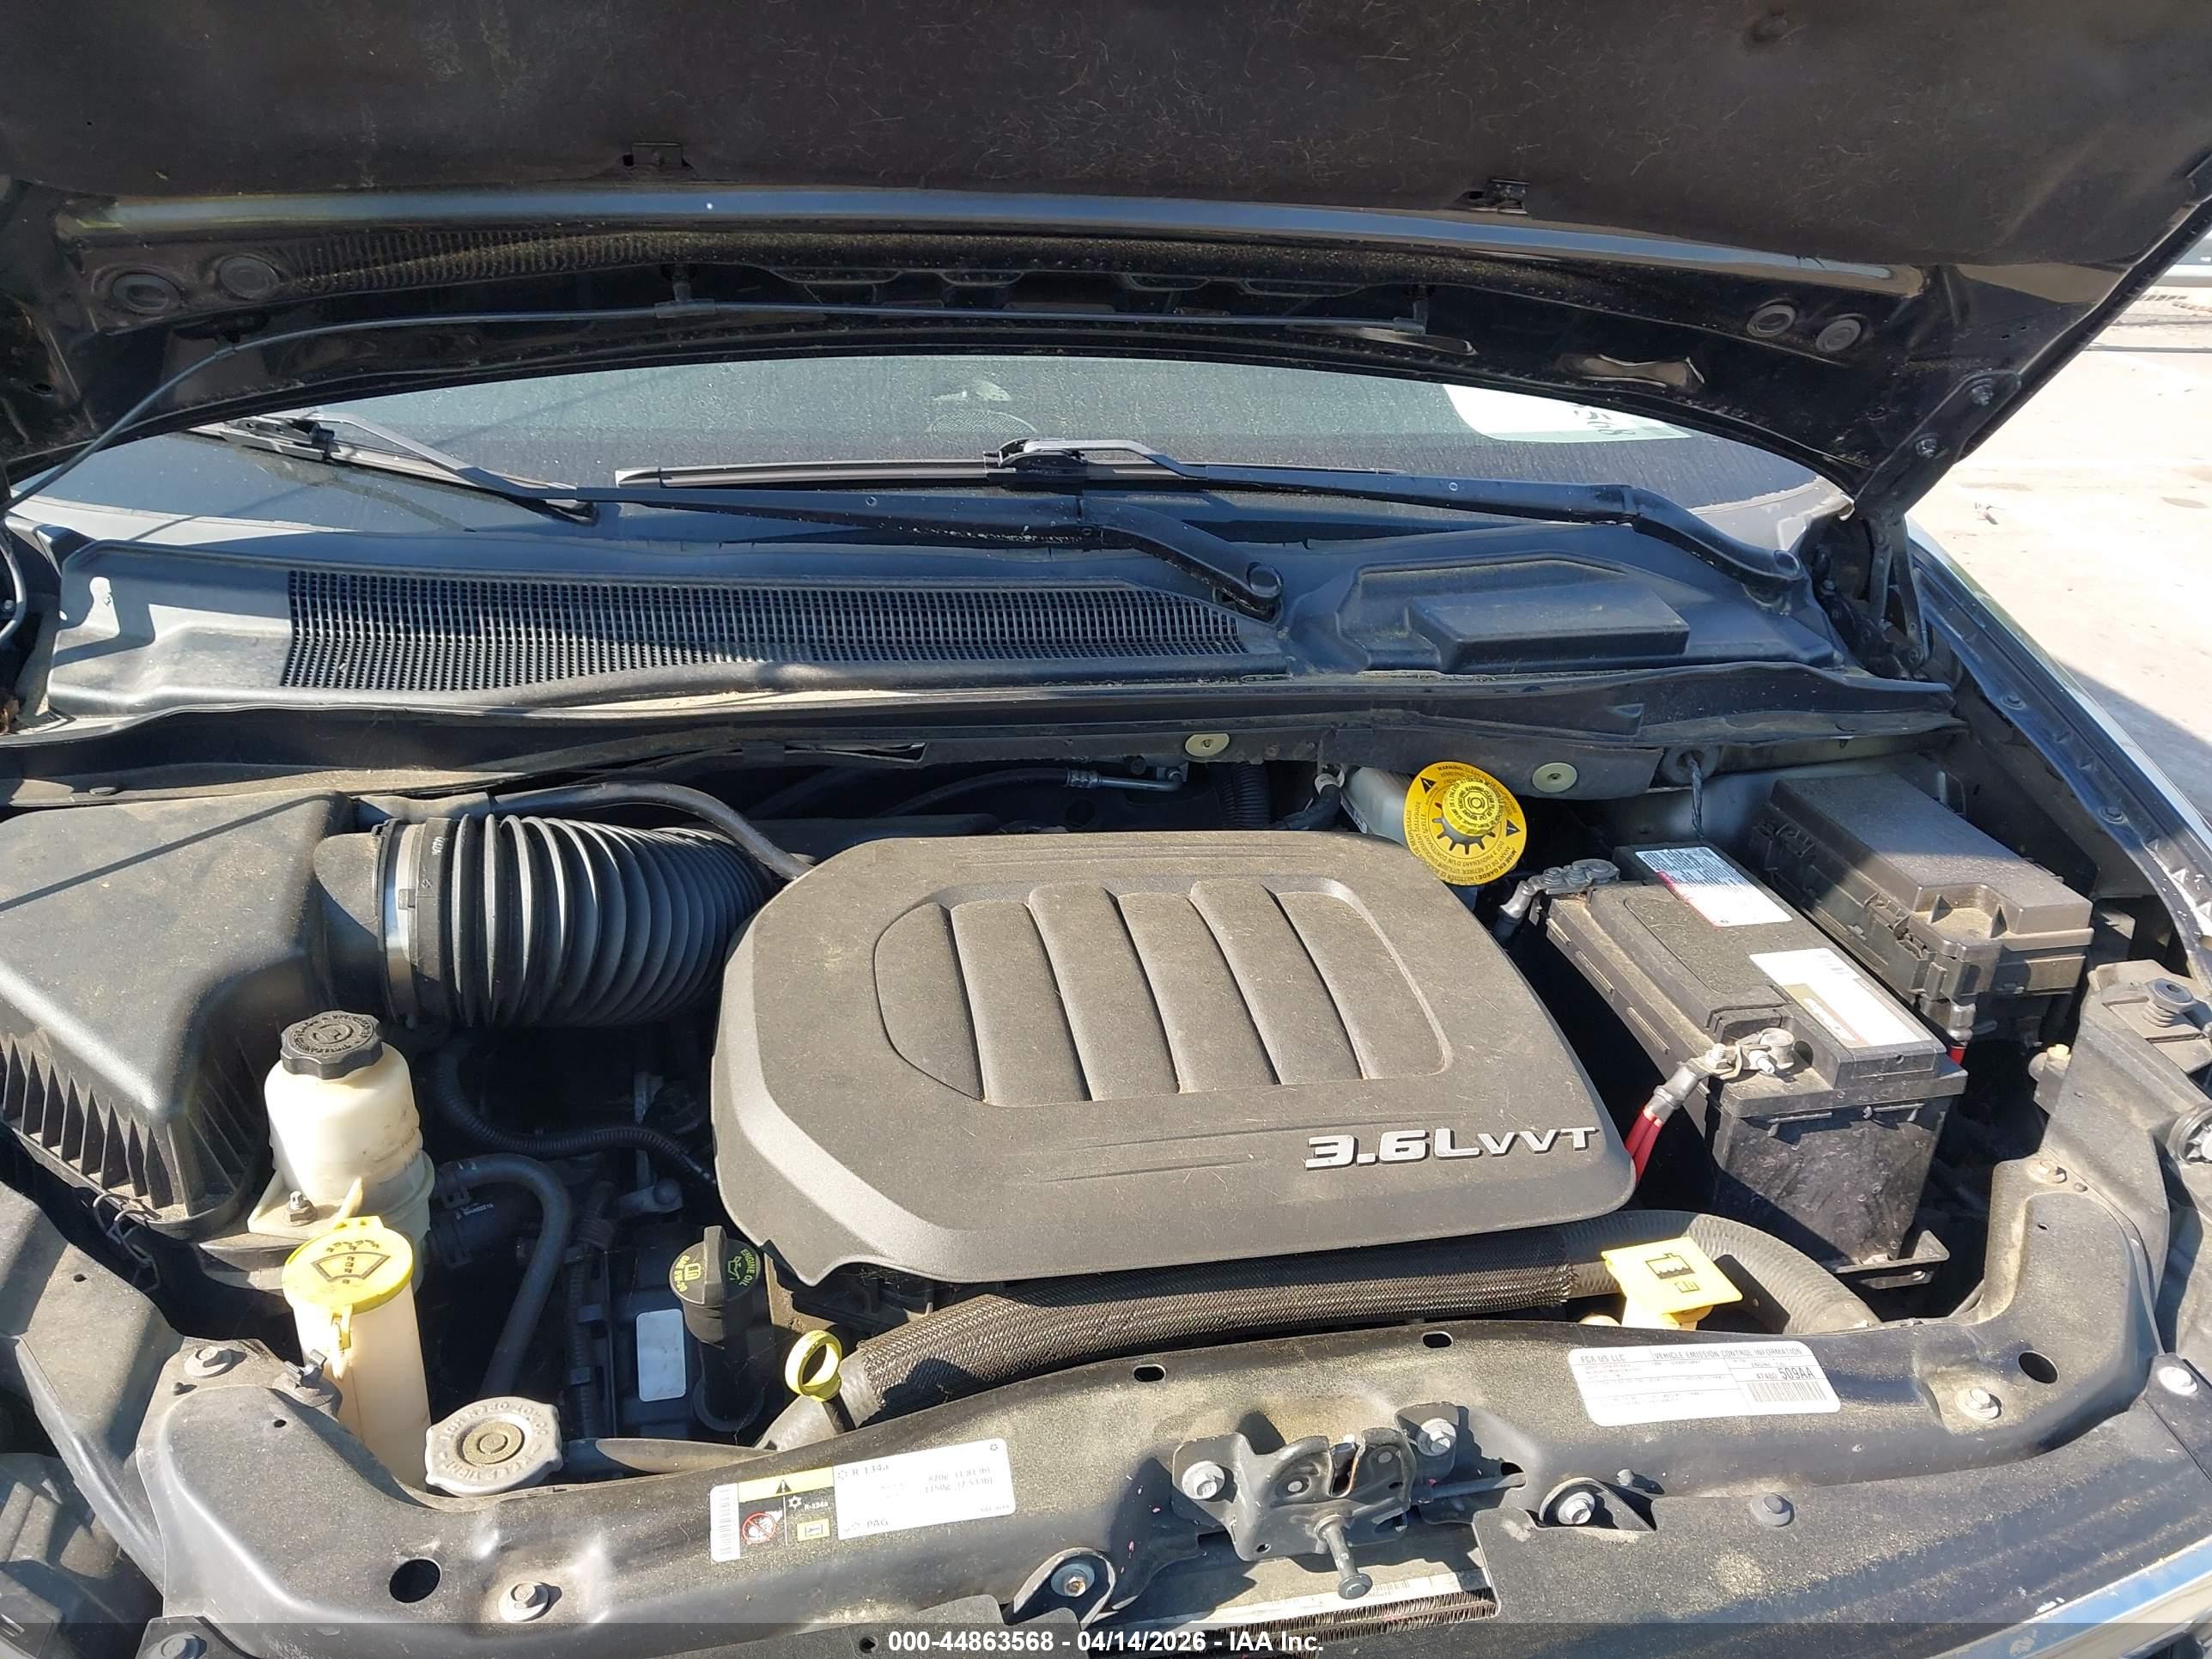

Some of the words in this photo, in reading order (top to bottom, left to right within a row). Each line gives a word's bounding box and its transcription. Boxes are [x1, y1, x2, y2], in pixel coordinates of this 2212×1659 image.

[740, 1249, 756, 1273] ENGINE
[738, 1275, 752, 1286] OIL
[1597, 1354, 1609, 1363] US
[1610, 1353, 1626, 1362] LLC
[1654, 1351, 1685, 1360] VEHICLE
[1686, 1349, 1720, 1358] EMISSION
[1721, 1348, 1753, 1358] CONTROL
[1754, 1346, 1802, 1356] INFORMATION
[1778, 1366, 1815, 1381] 509AA
[866, 1518, 890, 1528] PAG
